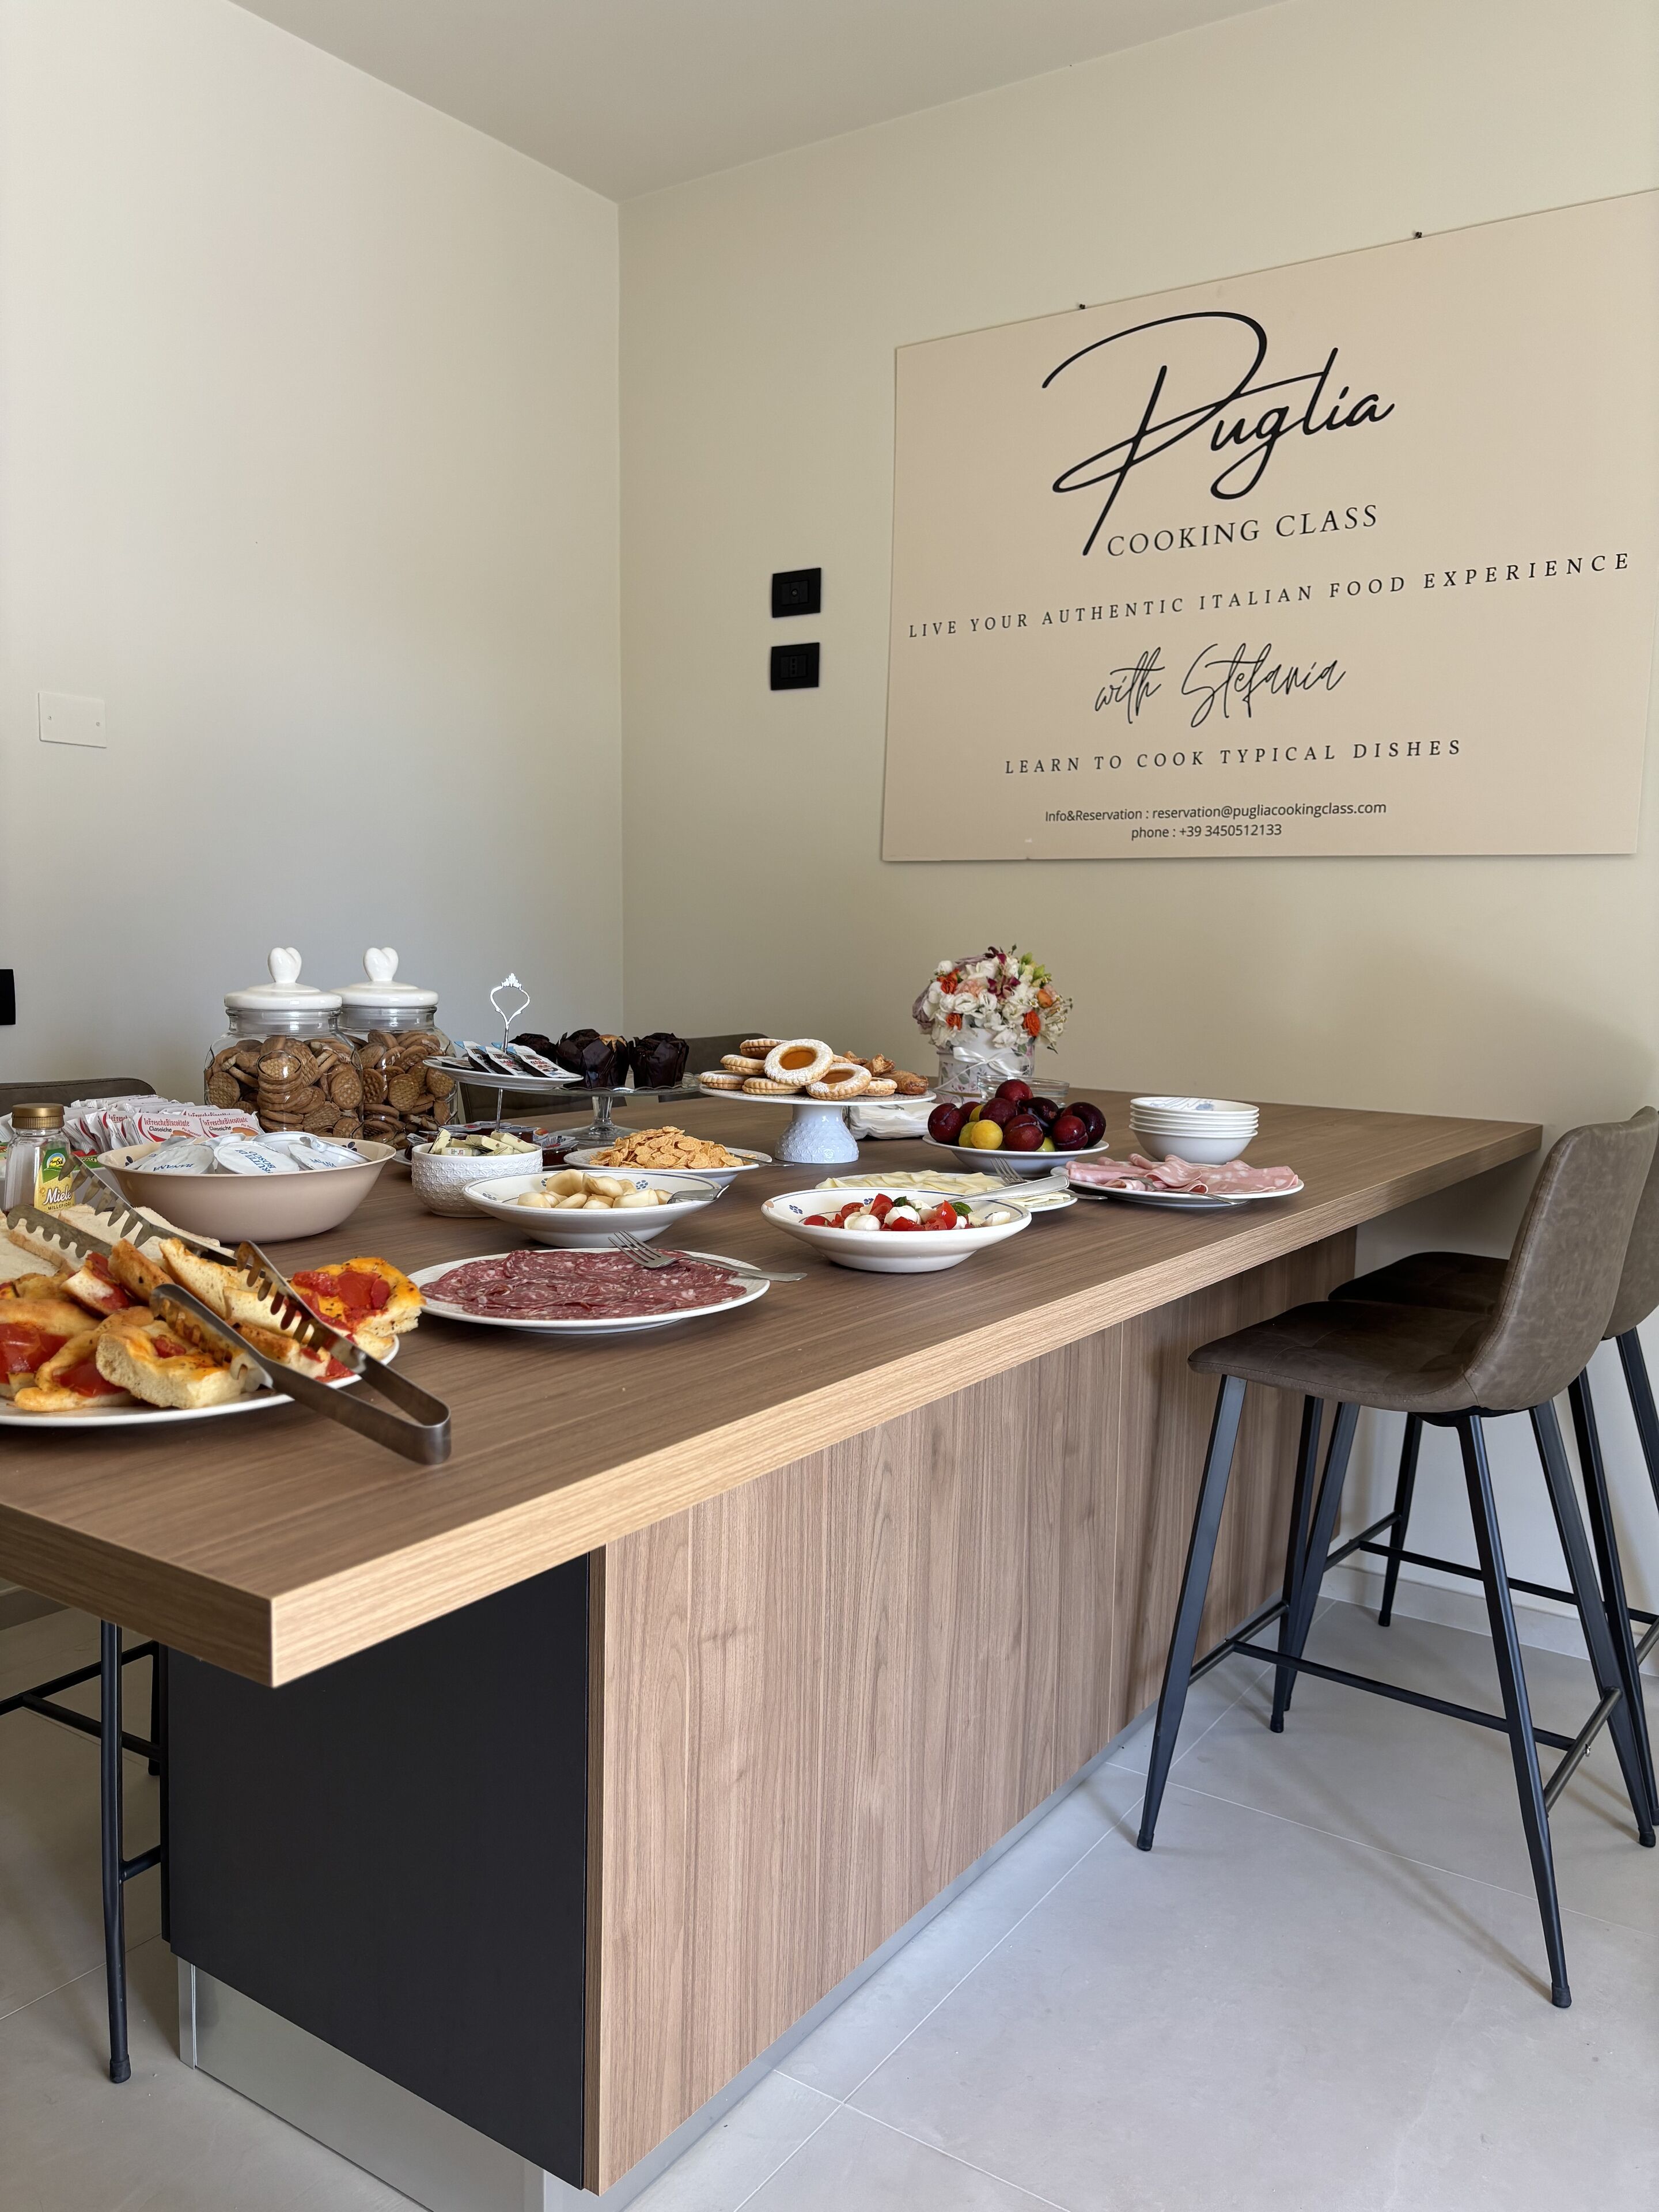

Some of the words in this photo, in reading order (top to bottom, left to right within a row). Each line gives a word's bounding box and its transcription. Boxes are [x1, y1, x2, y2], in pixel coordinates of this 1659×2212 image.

[1042, 312, 1395, 556] Puglia
[1107, 520, 1260, 556] COOKING
[1275, 504, 1377, 537] CLASS
[909, 620, 956, 638] LIVE
[970, 613, 1028, 632] YOUR
[1041, 598, 1183, 625] AUTHENTIC
[1199, 585, 1312, 610] ITALIAN
[1329, 577, 1404, 598] FOOD
[1423, 552, 1630, 589] EXPERIENCE
[1094, 646, 1166, 725] with
[1181, 642, 1347, 728] Stefania
[1005, 757, 1079, 774] LEARN
[1094, 755, 1122, 770] TO
[1137, 751, 1203, 768] COOK
[1219, 745, 1335, 764] TYPICAL
[1353, 740, 1460, 759] DISHES
[1046, 809, 1142, 822] Info&Reservation
[1152, 802, 1387, 821] reservation@pugliacookingclass.com
[1131, 827, 1169, 841] phone
[1179, 825, 1202, 838] +39
[1204, 823, 1282, 837] 3450512133
[248, 1151, 277, 1169] BOSCO
[43, 1184, 73, 1206] Miele
